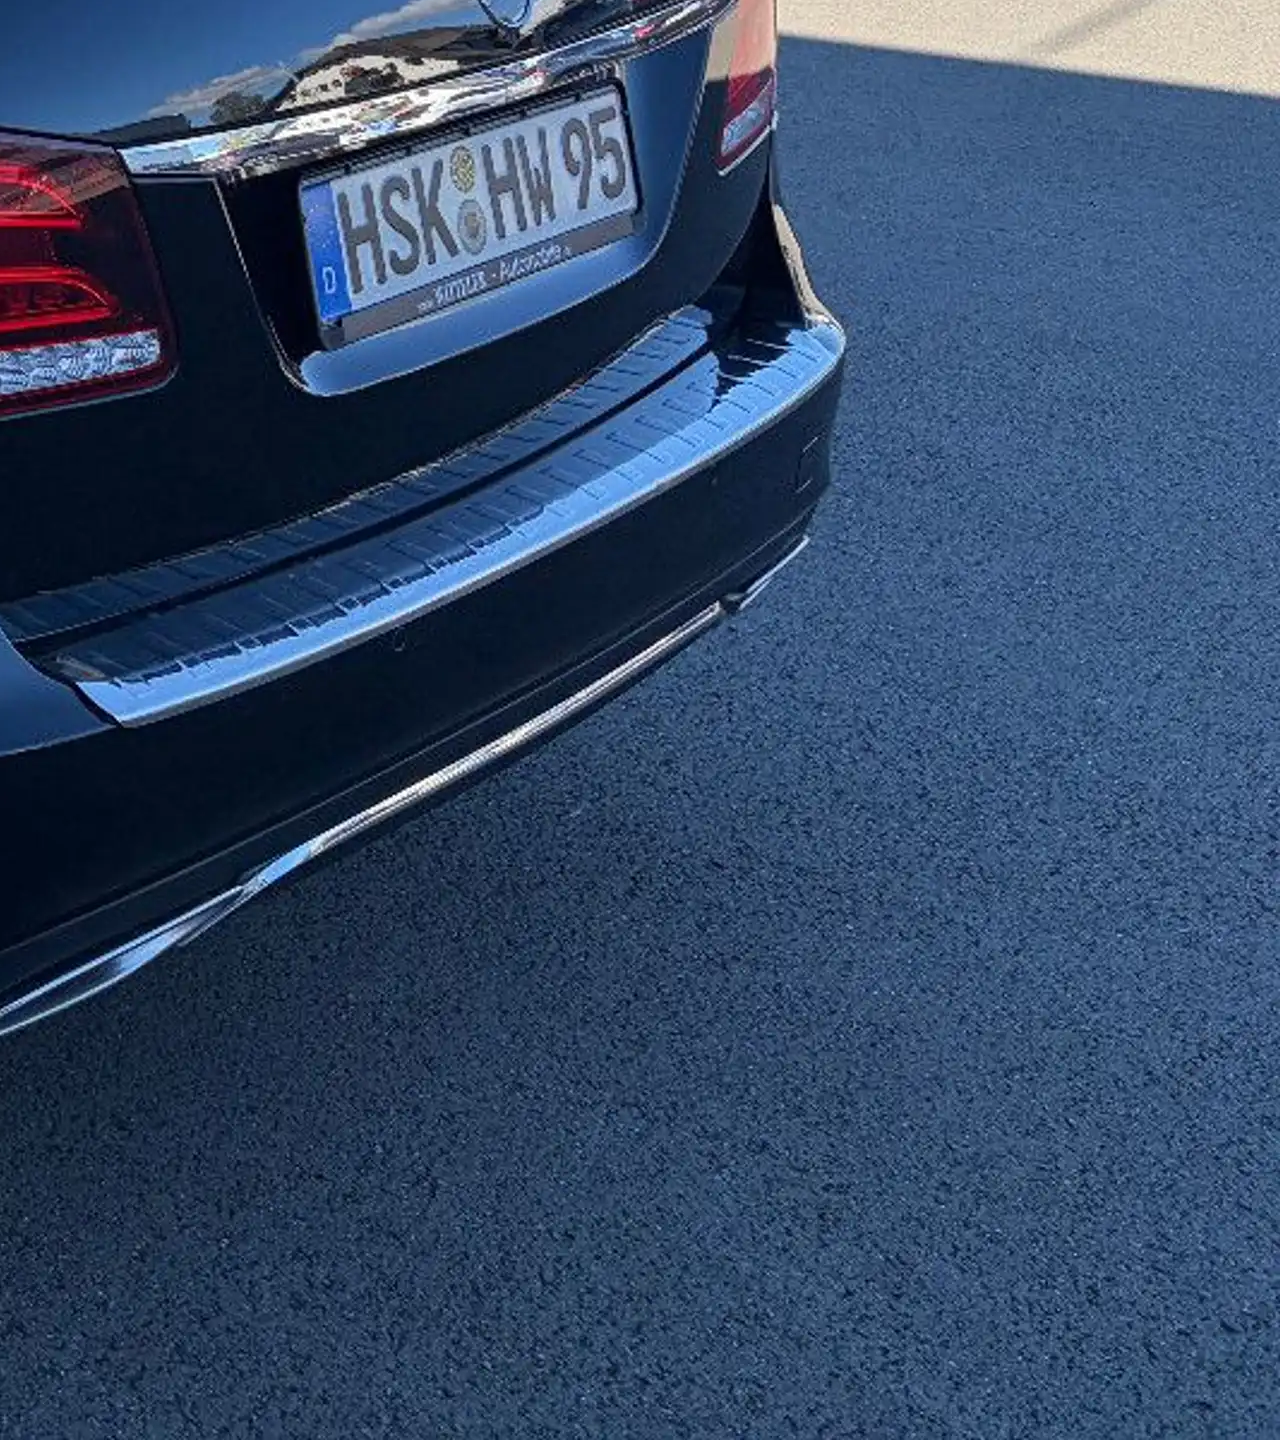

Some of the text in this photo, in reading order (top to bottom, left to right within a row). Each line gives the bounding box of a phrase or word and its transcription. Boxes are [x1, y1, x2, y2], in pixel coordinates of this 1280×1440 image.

[337, 160, 460, 295] HSK
[481, 126, 556, 242] HW
[562, 106, 627, 210] 95
